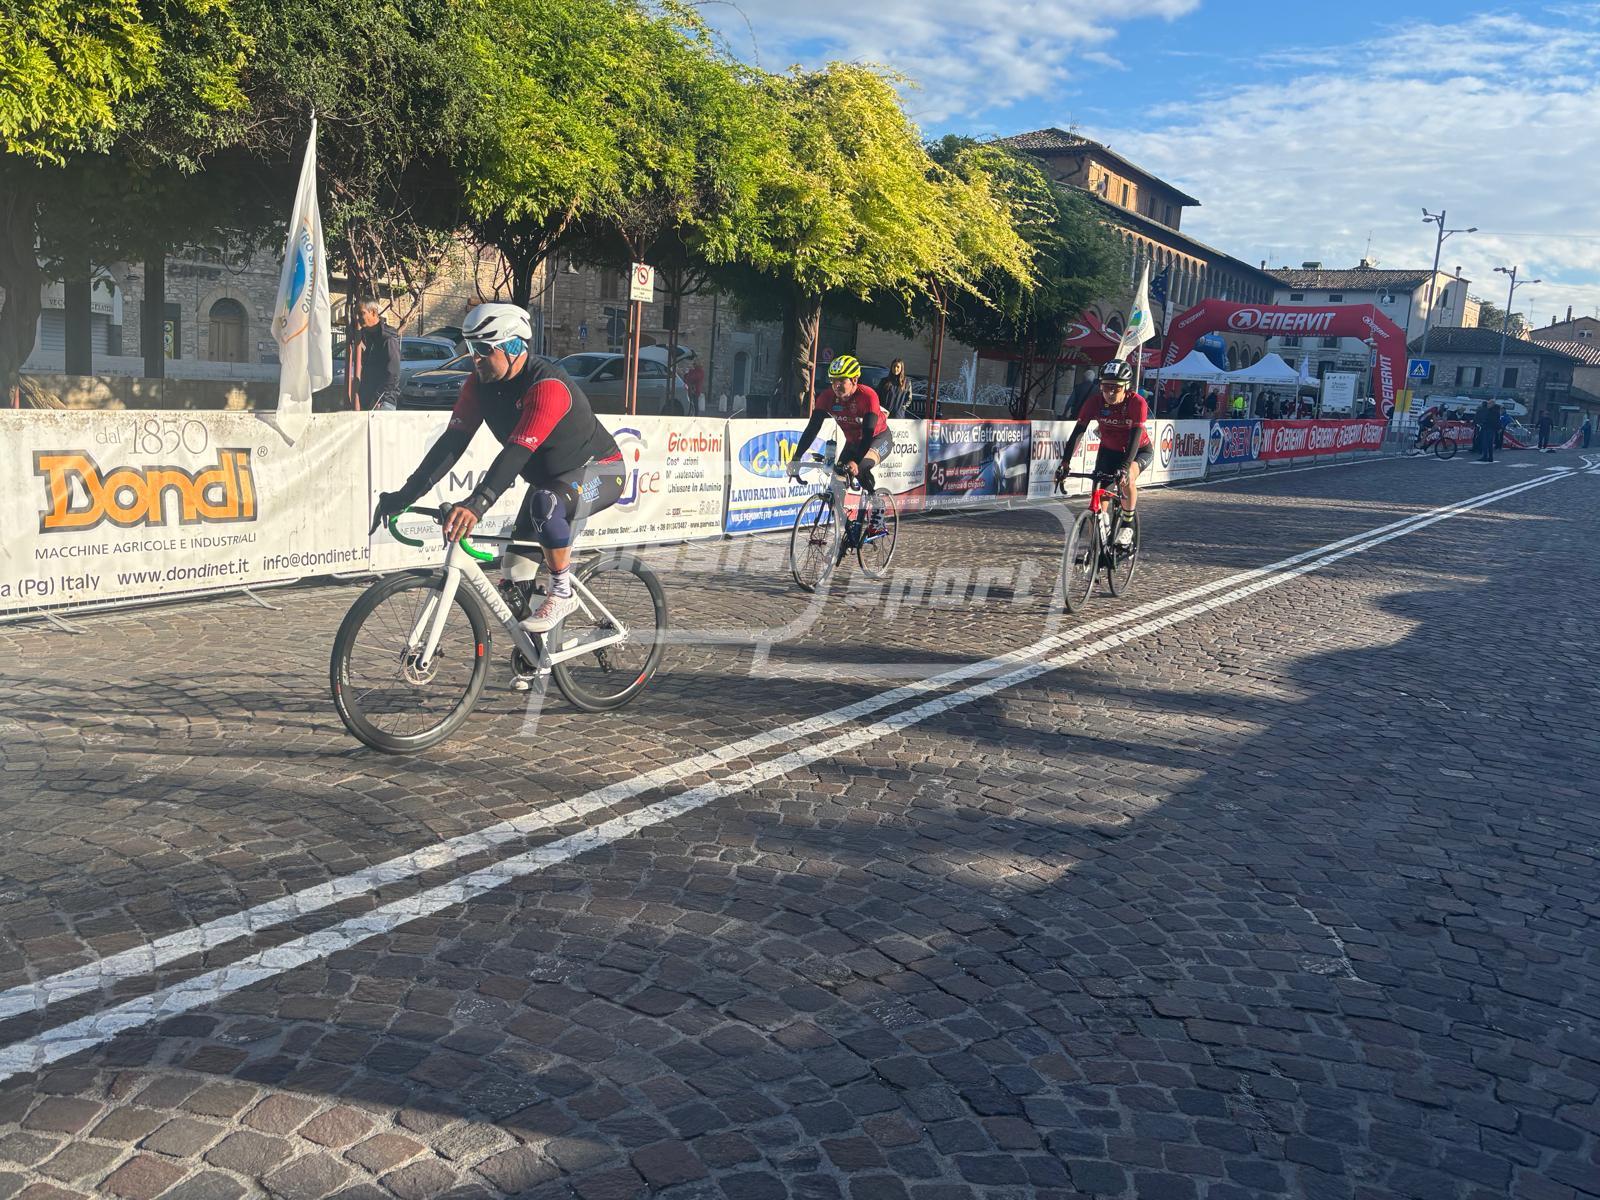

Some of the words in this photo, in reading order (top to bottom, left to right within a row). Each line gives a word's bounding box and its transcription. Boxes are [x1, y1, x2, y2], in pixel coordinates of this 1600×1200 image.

[1258, 312, 1336, 331] ENERVIT
[1379, 354, 1393, 400] ENERVIT
[95, 422, 121, 445] dal
[128, 419, 208, 455] 1850
[668, 432, 723, 453] Giombini
[941, 426, 969, 444] Nuova
[972, 425, 1024, 444] Elettrodiesel
[666, 456, 699, 466] Cosuzioni
[665, 469, 704, 479] Mutenzioni
[931, 463, 945, 487] 25
[32, 447, 258, 534] Dondi
[731, 486, 787, 503] LAVORAZIONI
[35, 543, 109, 560] MACCHINE
[113, 538, 178, 554] AGRICOLE
[181, 537, 188, 549] E
[190, 533, 257, 548] INDUSTRIALI
[18, 576, 55, 598] (Pg)
[61, 573, 100, 595] Italy
[117, 559, 250, 586] www.dondinet.it
[263, 545, 370, 571] info@dondinet.it
[469, 574, 490, 603] VAN
